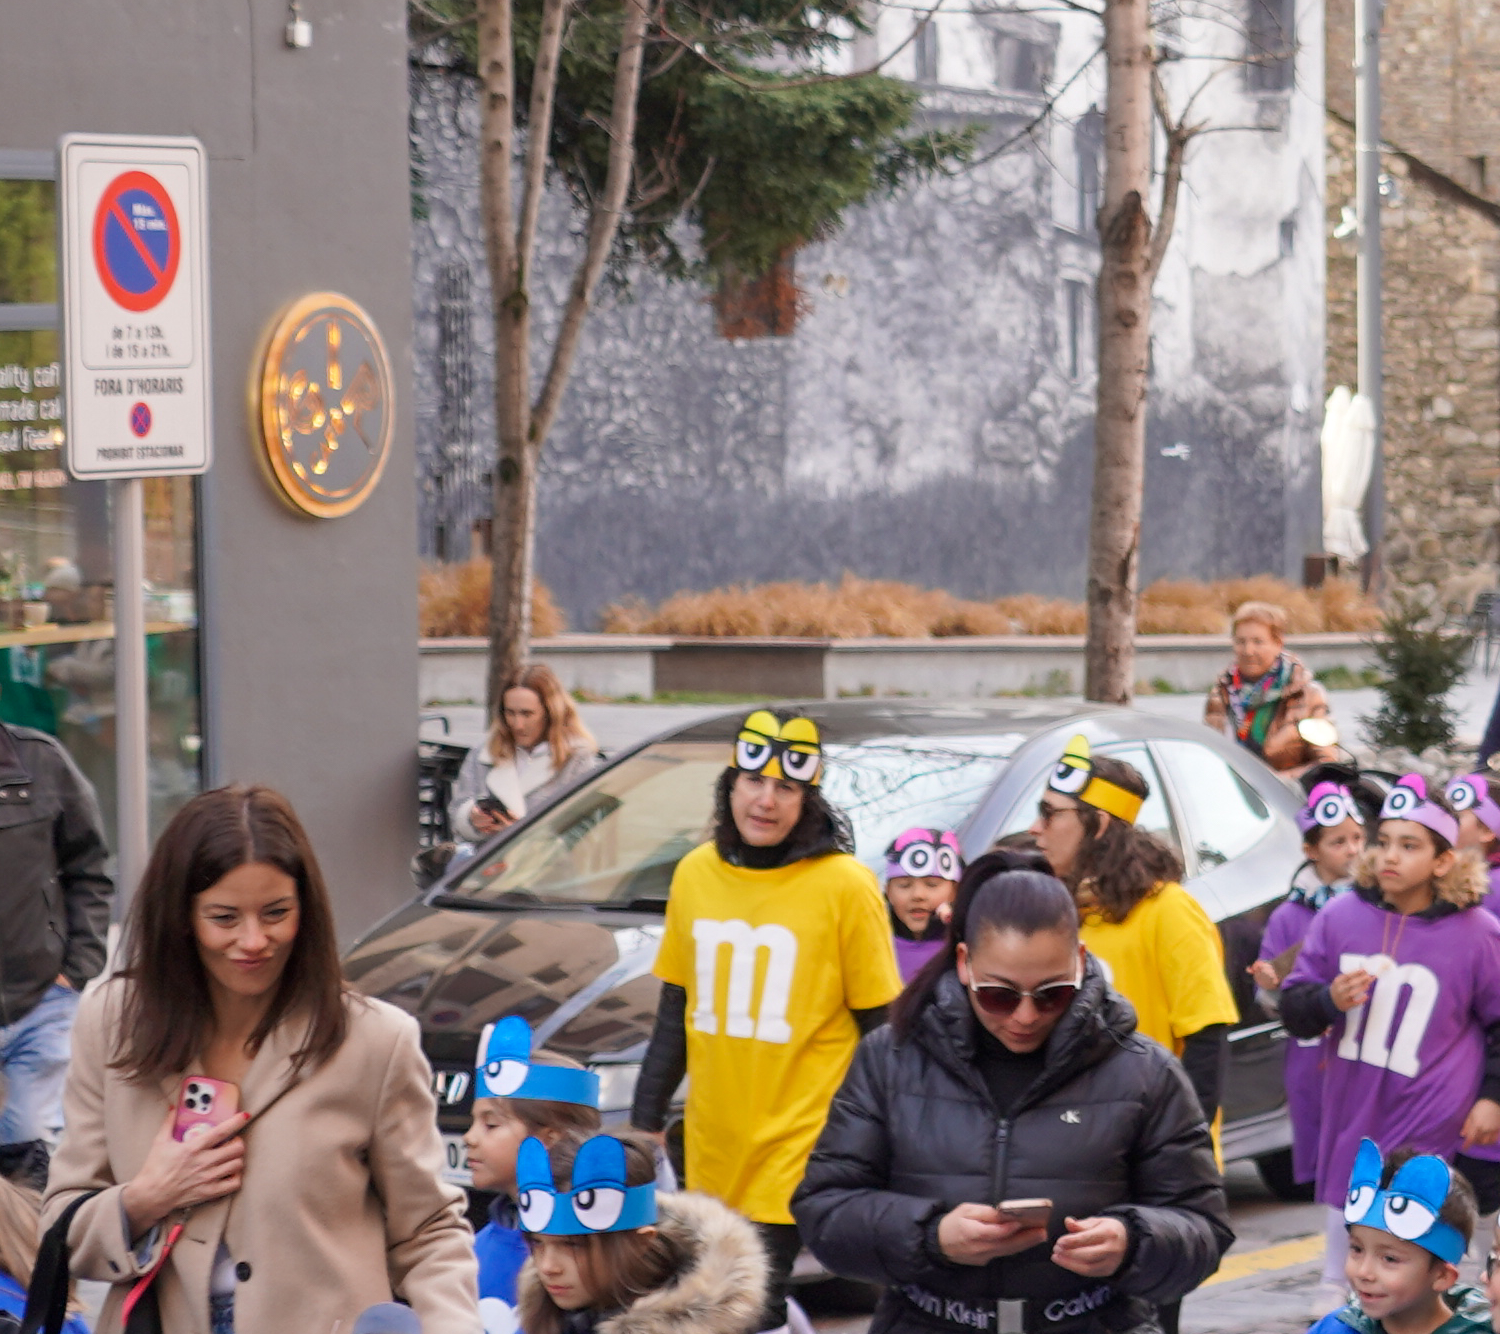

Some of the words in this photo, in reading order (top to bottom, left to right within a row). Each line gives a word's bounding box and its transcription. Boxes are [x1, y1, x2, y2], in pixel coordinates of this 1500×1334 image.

[94, 378, 122, 395] FORA
[126, 377, 184, 395] D'HORARIS
[692, 918, 798, 1044] m
[1337, 952, 1440, 1079] m
